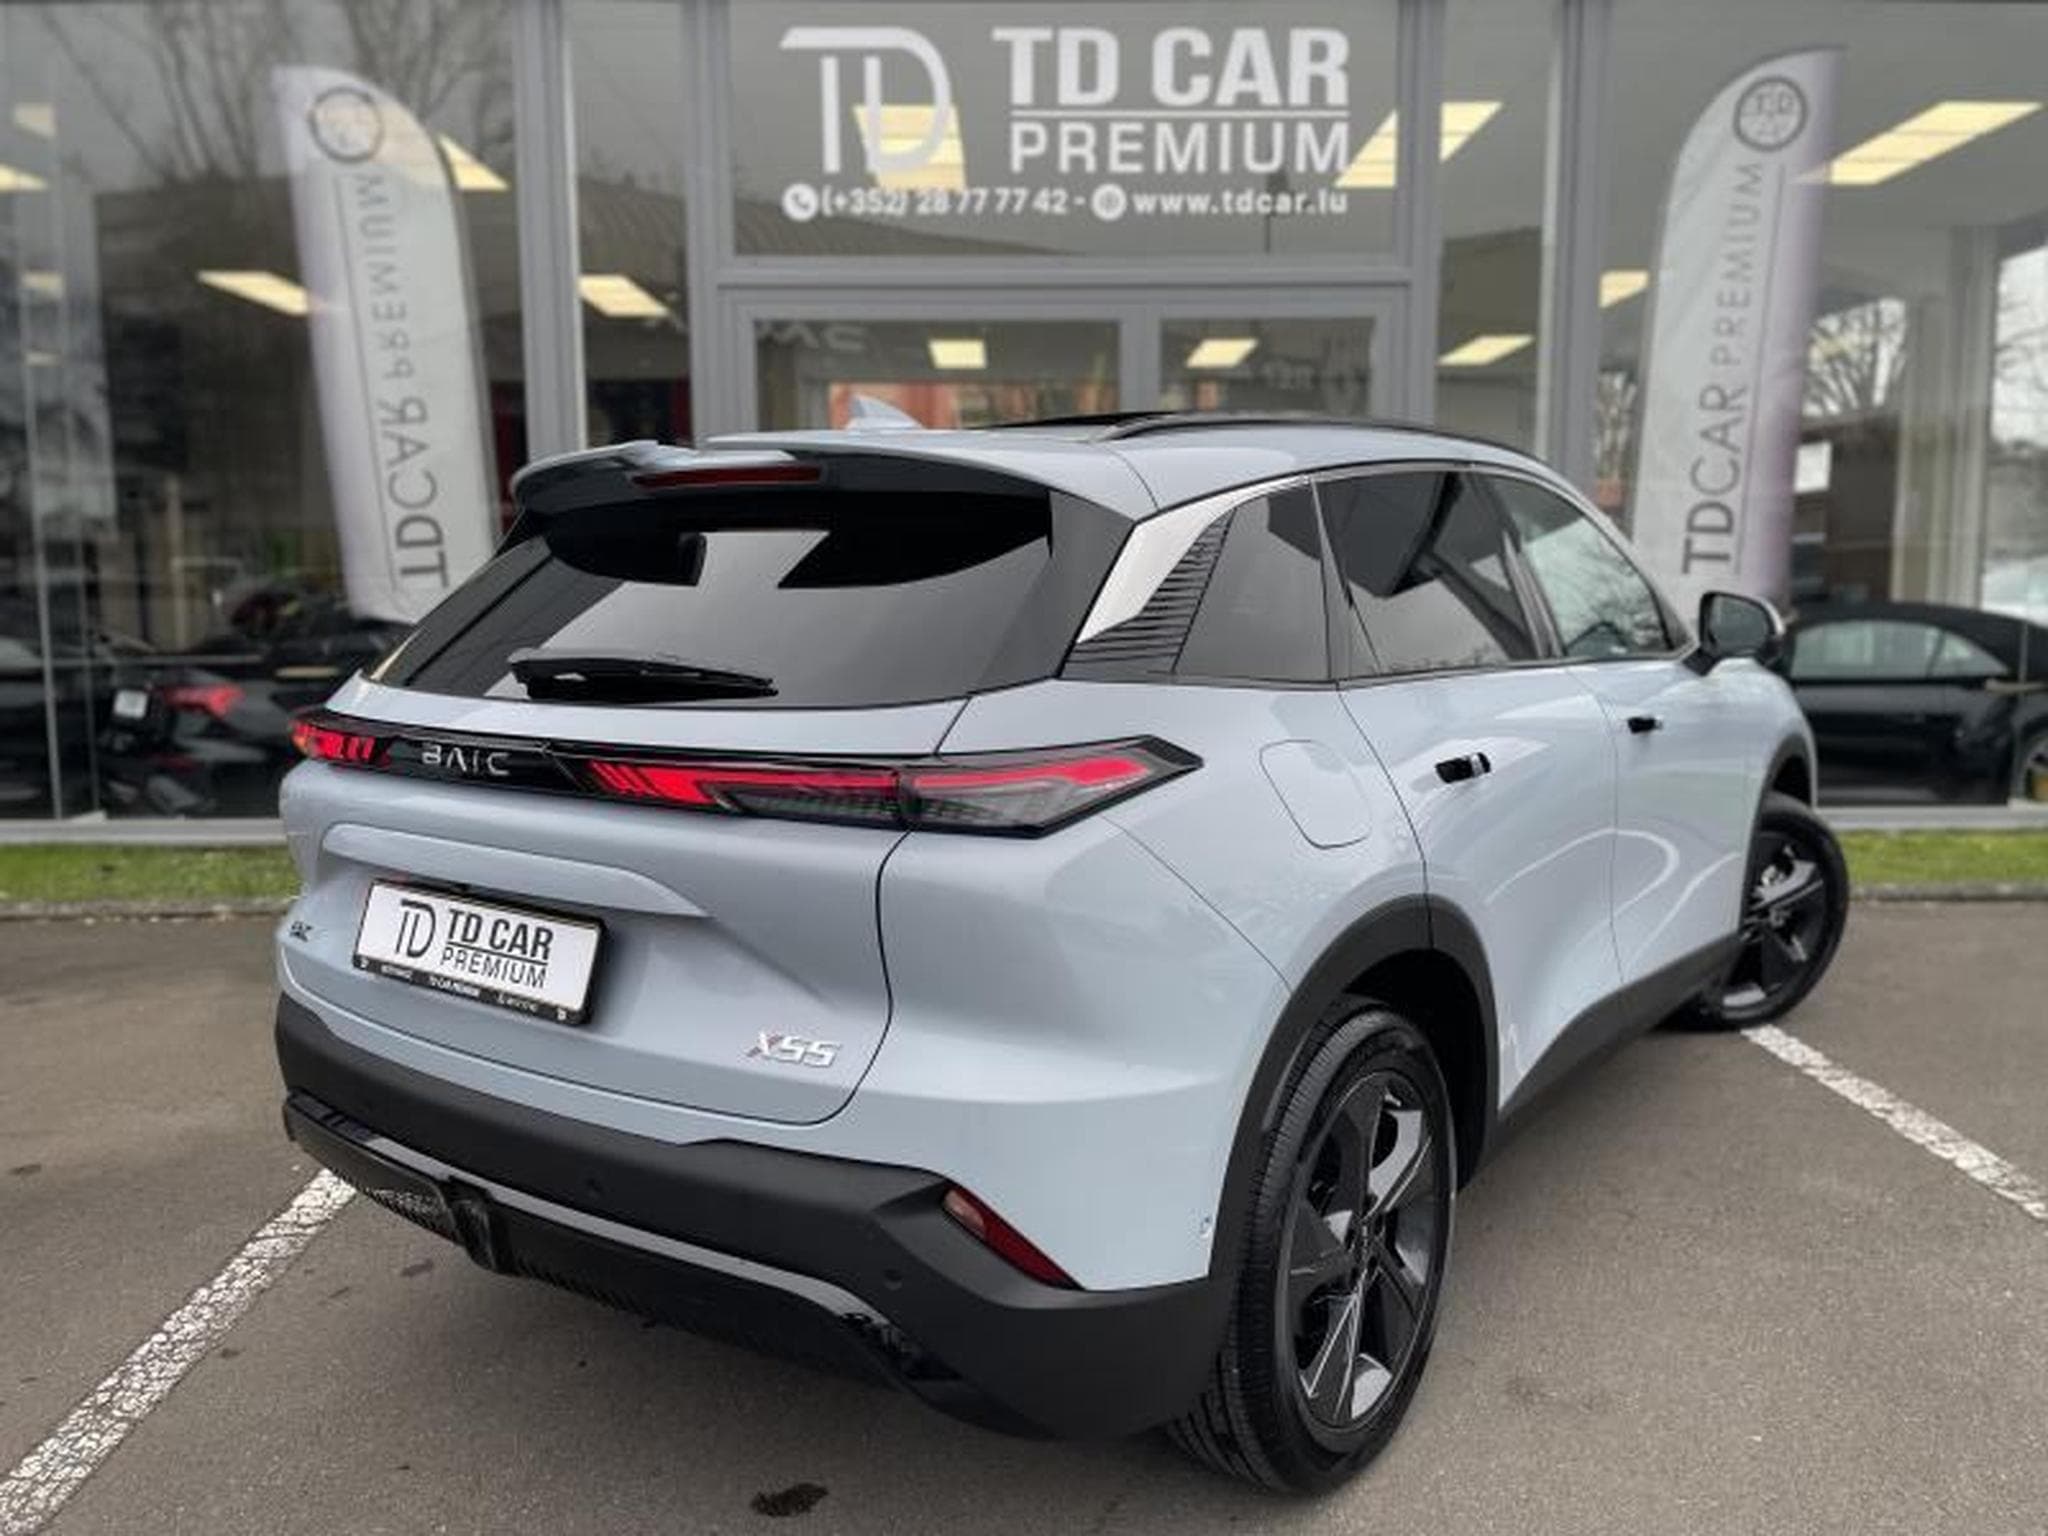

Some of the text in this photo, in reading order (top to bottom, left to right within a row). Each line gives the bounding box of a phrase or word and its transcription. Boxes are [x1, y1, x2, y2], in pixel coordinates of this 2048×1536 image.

[992, 27, 1350, 106] TD CAR
[1010, 122, 1350, 174] PREMIUM
[1131, 188, 1348, 215] www.tdcar.lu
[1681, 161, 1763, 575] TDCAR PREMIUM
[421, 744, 509, 776] BAIC
[448, 908, 554, 961] TD CAR
[440, 946, 548, 990] PREMIUM
[745, 1032, 843, 1068] X55
